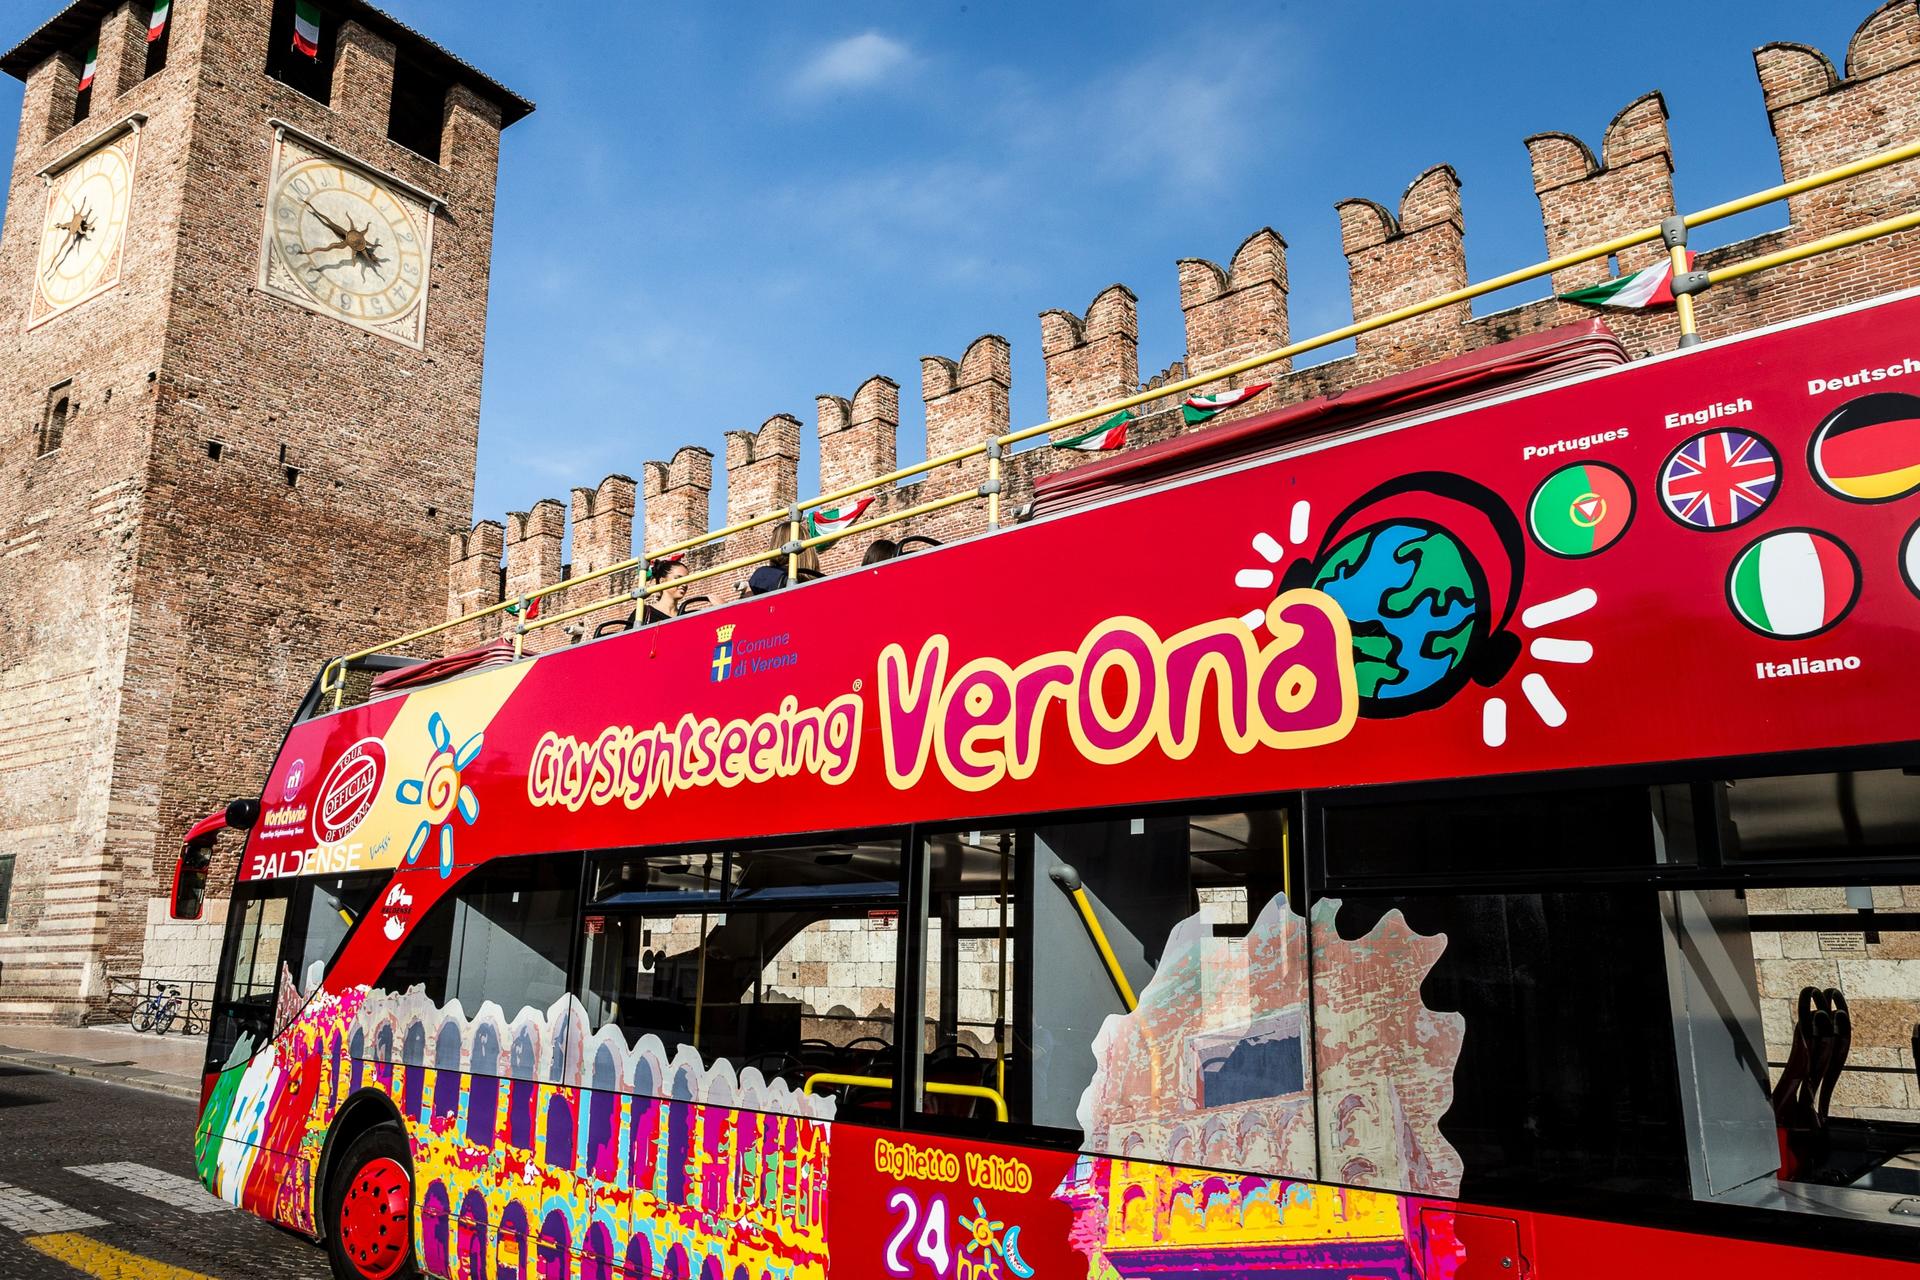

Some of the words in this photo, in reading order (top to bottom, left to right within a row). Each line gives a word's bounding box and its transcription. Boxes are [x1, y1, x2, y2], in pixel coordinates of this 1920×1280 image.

[290, 177, 311, 197] 10
[1808, 358, 1920, 396] Deutsch
[1664, 397, 1753, 430] English
[1522, 426, 1630, 461] Portugues
[736, 632, 790, 656] Comune
[733, 662, 747, 678] di
[751, 652, 798, 674] Verona
[1756, 656, 1861, 679] Italiano
[339, 746, 363, 772] TOUR
[325, 767, 374, 817] OFFICIAL
[325, 829, 337, 842] OF
[338, 801, 371, 839] VERONA
[875, 1138, 960, 1182] Biglietto
[965, 1152, 1032, 1193] Valido
[886, 1191, 950, 1276] 24
